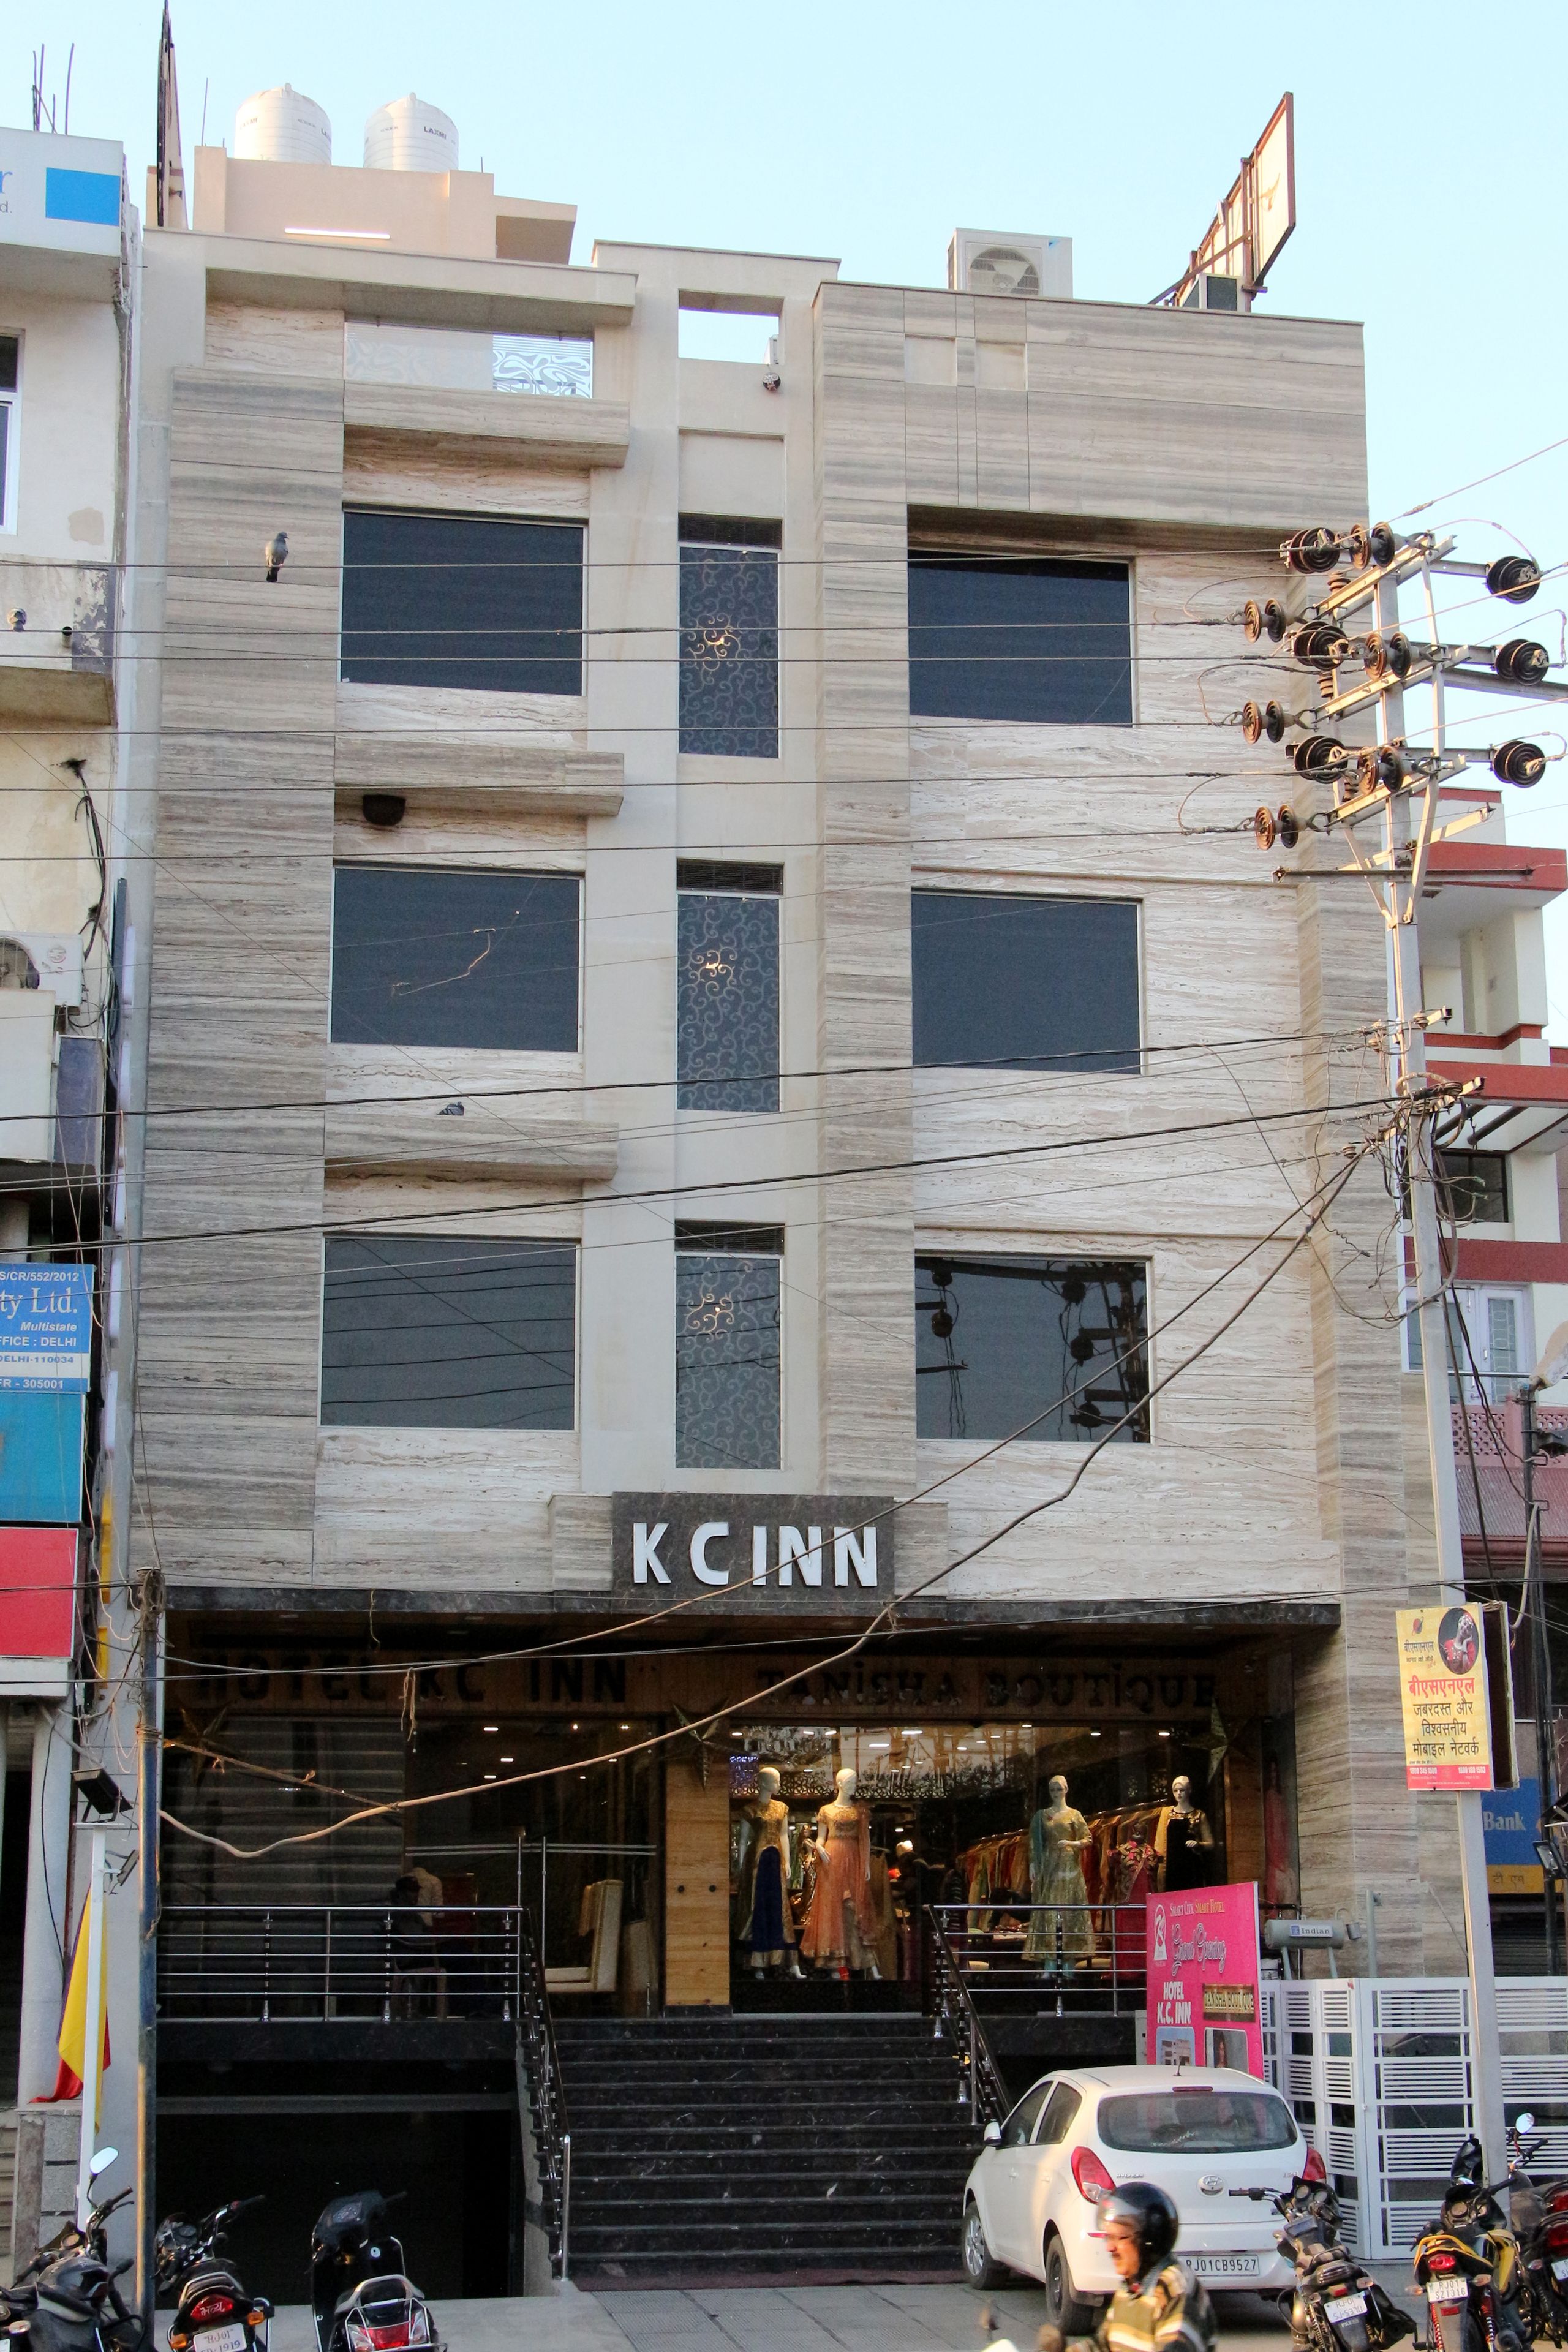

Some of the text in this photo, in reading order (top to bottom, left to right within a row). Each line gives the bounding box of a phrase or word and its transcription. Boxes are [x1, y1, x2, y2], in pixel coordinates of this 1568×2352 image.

[423, 126, 447, 140] LAXMI
[0, 1271, 80, 1281] S/CR/552/2012
[0, 1287, 78, 1319] ty Ltd.
[20, 1321, 77, 1332] Multistate
[40, 1337, 77, 1347] DELHI
[23, 1379, 64, 1389] 305001
[752, 1525, 878, 1586] INN
[1404, 1639, 1434, 1653] बीएसएनएल
[199, 1655, 627, 1702] HOTEL KC INN
[1408, 1675, 1475, 1698] बीएसएनएल
[1413, 1697, 1473, 1717] जबरदस्त और
[1422, 1718, 1466, 1736] विश्वसनीय
[1412, 1736, 1479, 1758] मोबाइल नेटवर्क
[1483, 1811, 1526, 1831] Bank
[1163, 1981, 1184, 2000] HOTEL
[1157, 2002, 1191, 2024] K.C. INN
[1186, 2259, 1256, 2271] RJ01CB9527
[1439, 2279, 1459, 2290] RJ01
